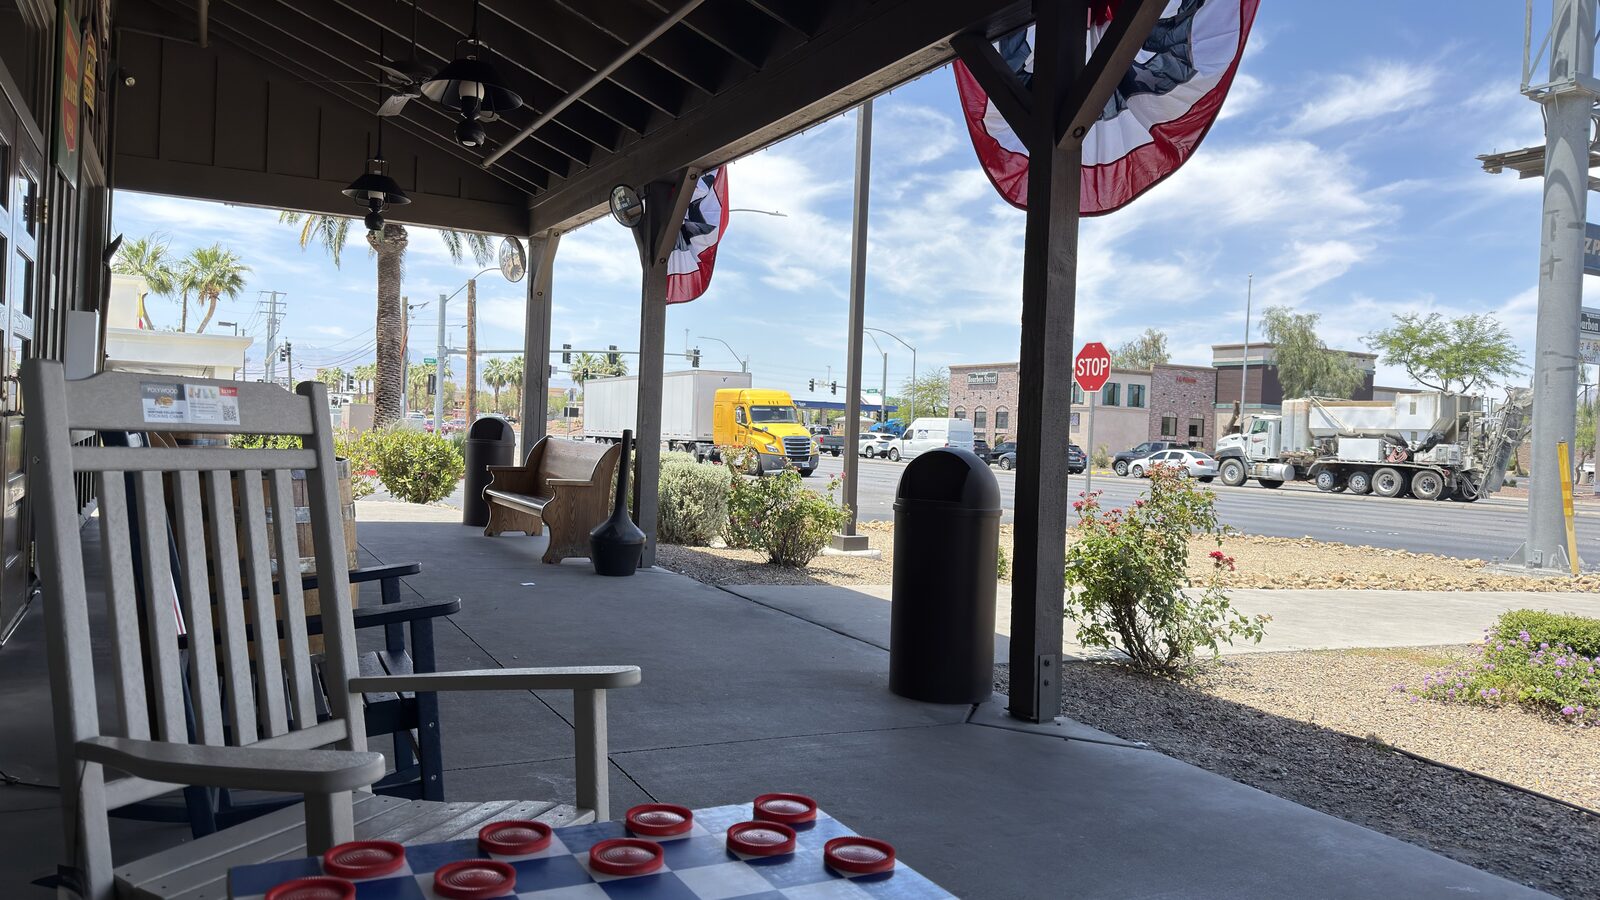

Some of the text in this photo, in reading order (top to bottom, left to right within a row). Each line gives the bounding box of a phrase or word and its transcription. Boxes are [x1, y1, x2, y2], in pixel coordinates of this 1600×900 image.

[1584, 237, 1600, 256] ZP
[1581, 318, 1599, 332] urbon
[1076, 357, 1109, 377] STOP
